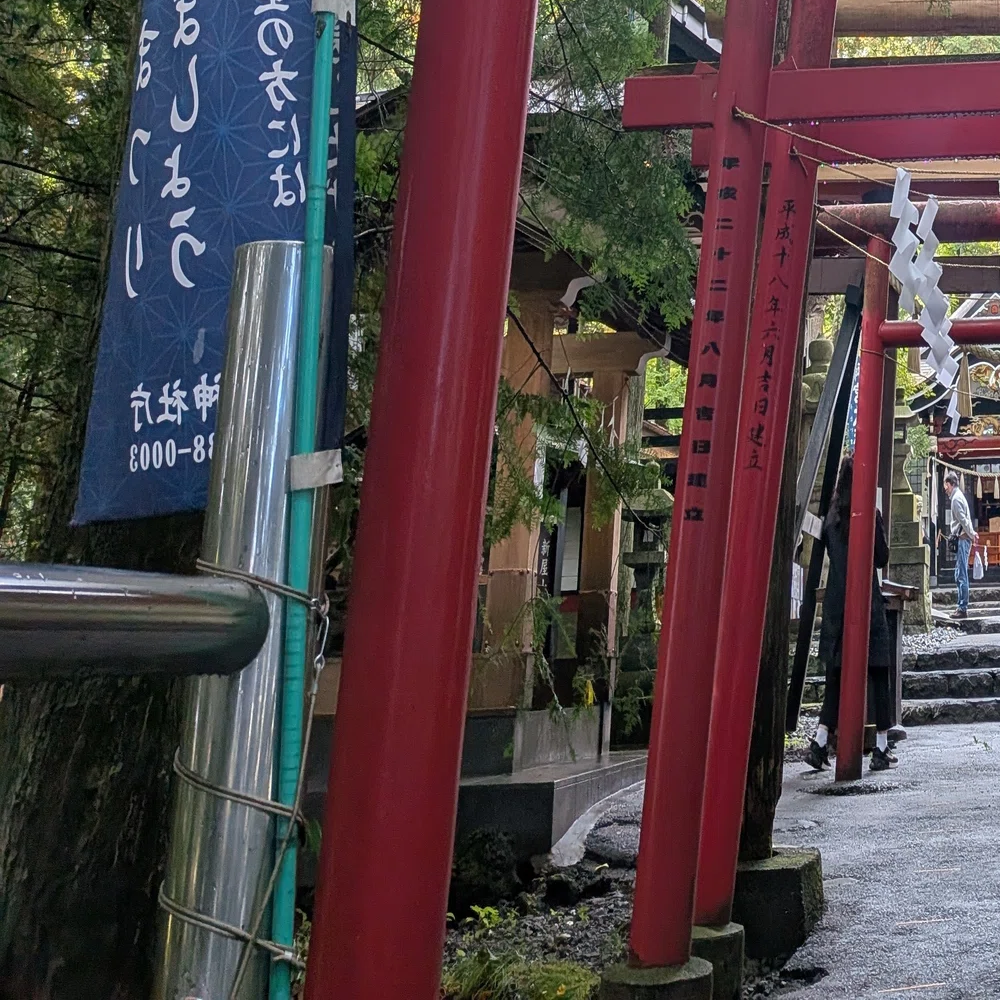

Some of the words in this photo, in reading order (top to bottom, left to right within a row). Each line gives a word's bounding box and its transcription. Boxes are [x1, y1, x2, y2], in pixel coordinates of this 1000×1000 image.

[743, 199, 797, 472] 平成十八年六月吉日建立
